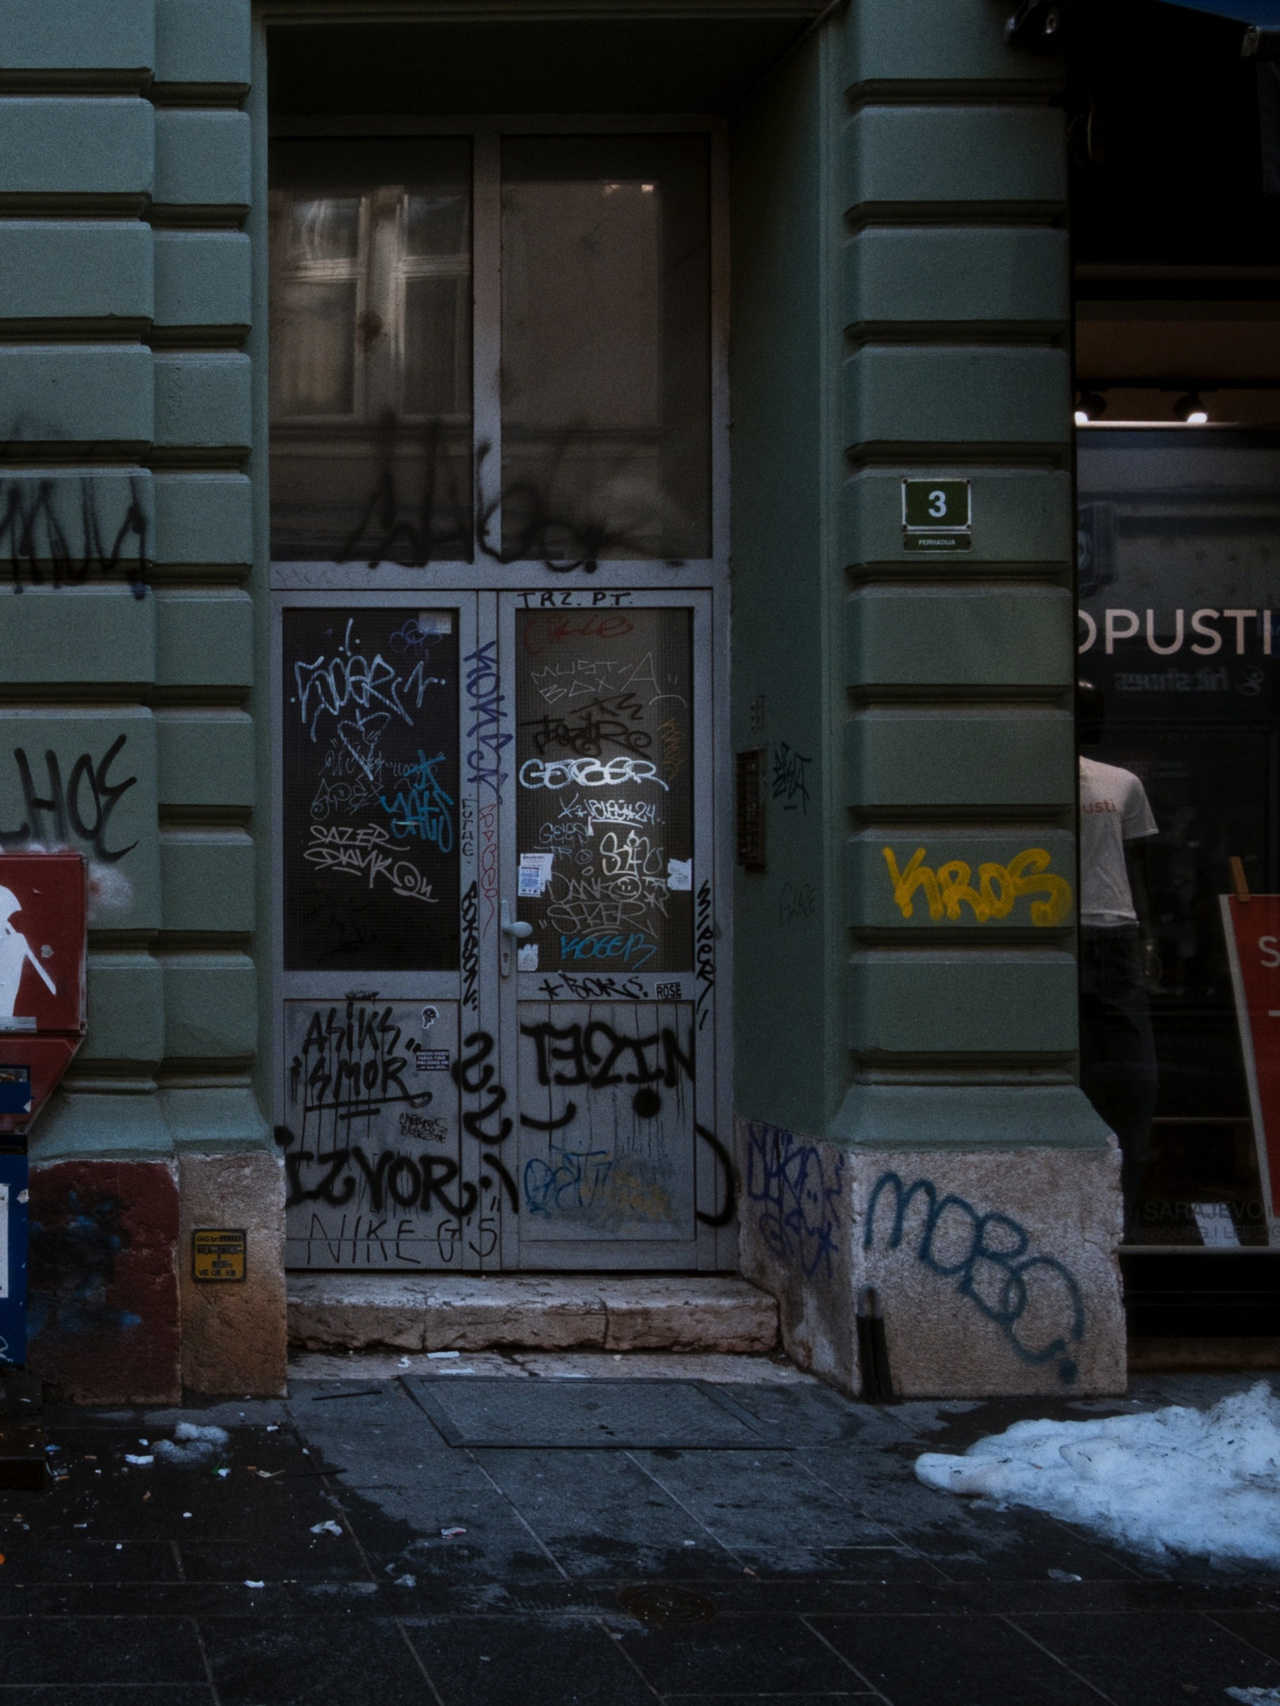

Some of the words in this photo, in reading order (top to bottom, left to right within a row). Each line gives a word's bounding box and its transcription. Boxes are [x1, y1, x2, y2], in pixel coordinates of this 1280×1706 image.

[928, 490, 947, 518] 3
[656, 983, 682, 998] ROSE
[1144, 1201, 1263, 1220] SARAJEVO
